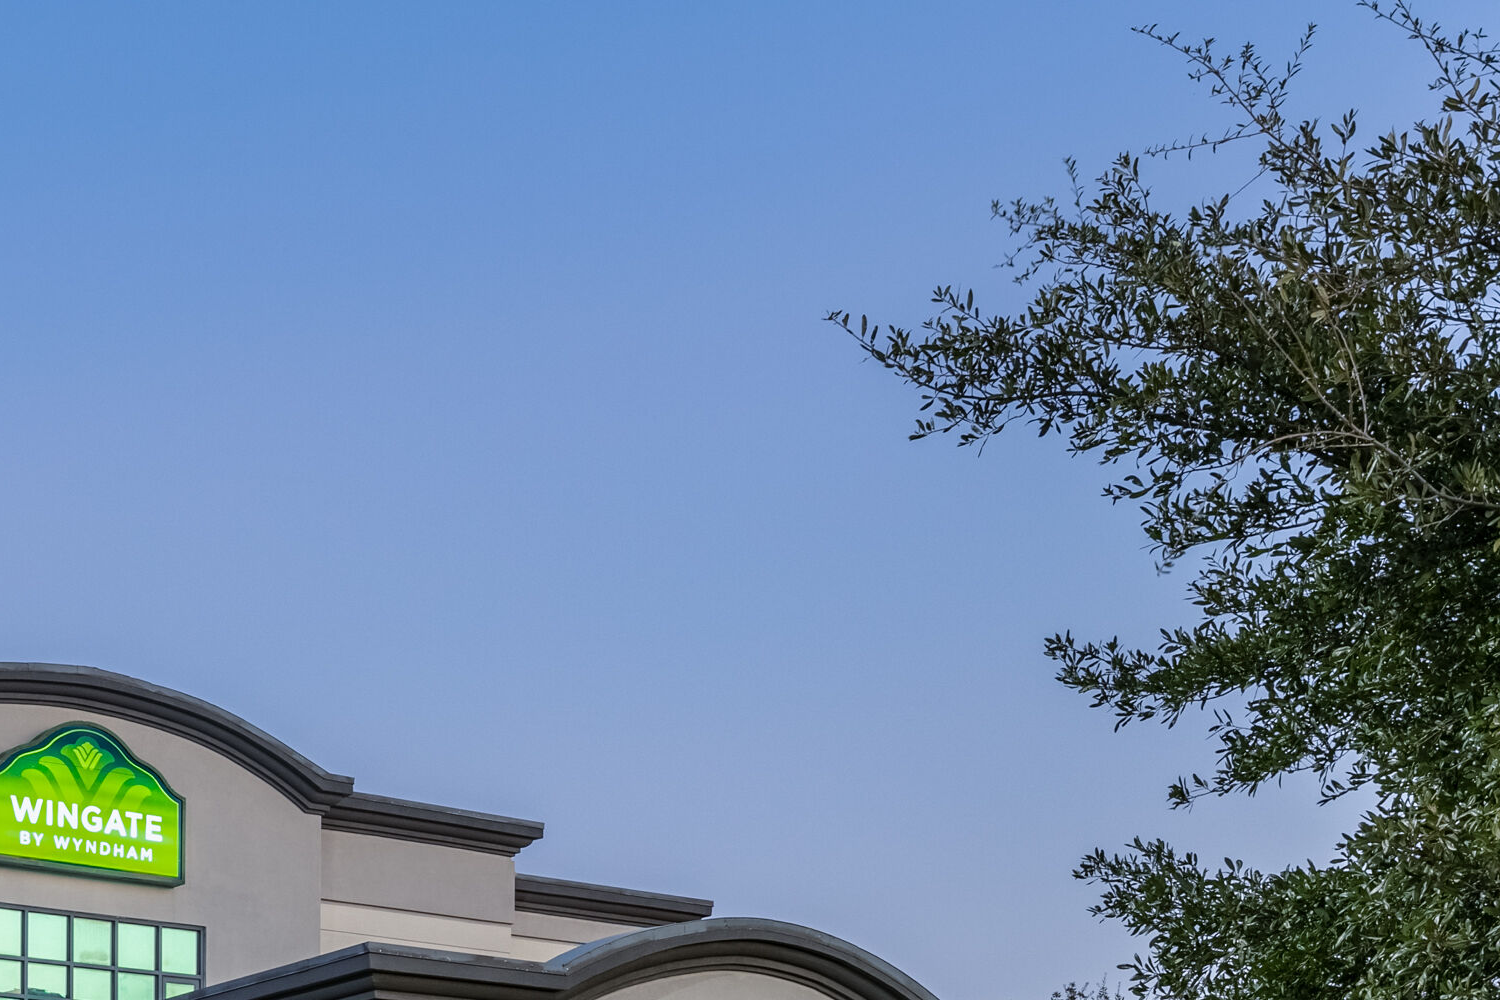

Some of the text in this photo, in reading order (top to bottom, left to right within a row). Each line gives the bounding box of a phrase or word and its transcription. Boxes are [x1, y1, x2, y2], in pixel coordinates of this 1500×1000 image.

[10, 794, 163, 842] WINGATE
[19, 830, 153, 862] BY WYNDHAM
